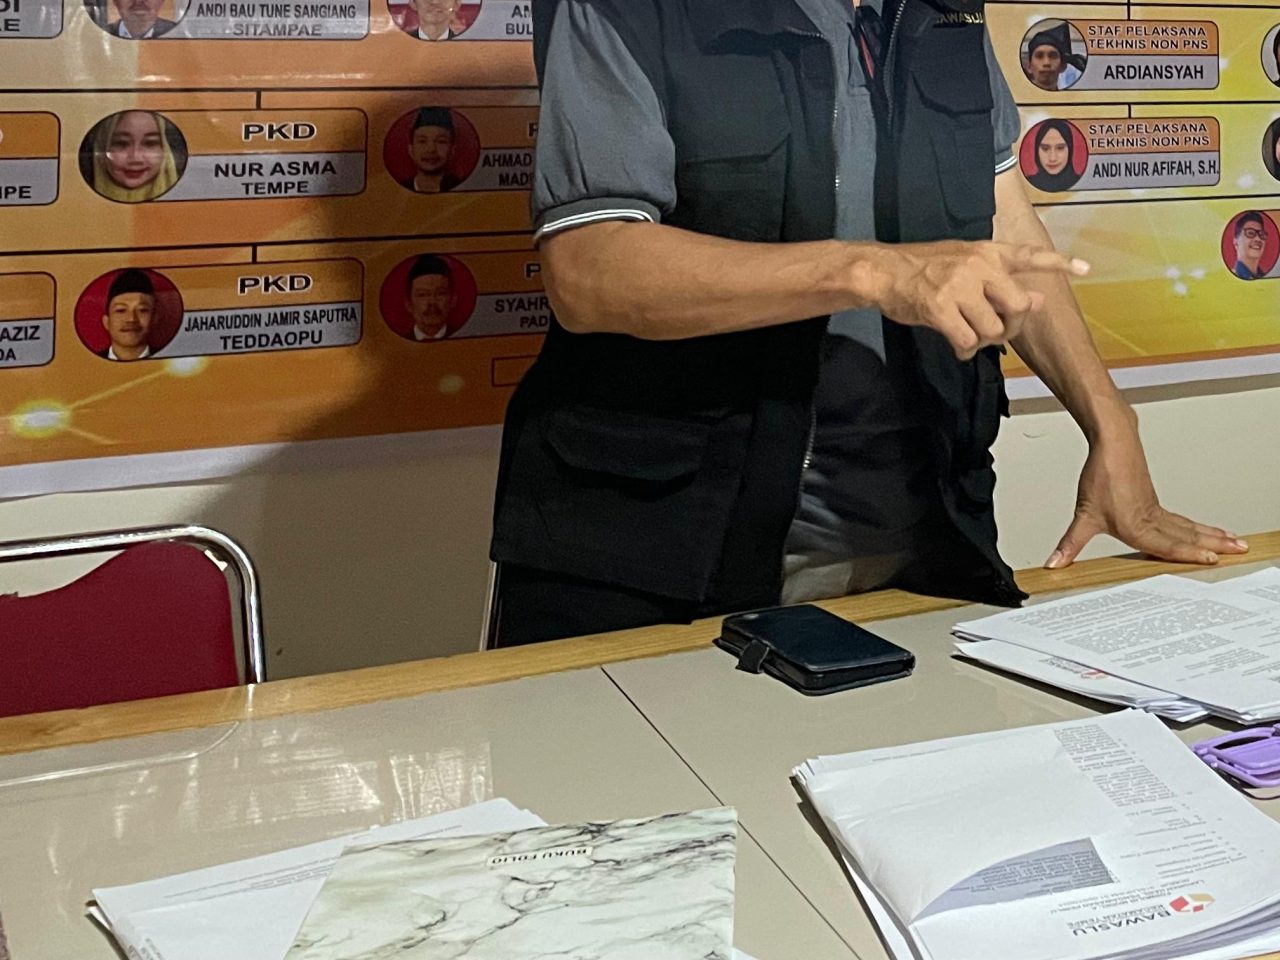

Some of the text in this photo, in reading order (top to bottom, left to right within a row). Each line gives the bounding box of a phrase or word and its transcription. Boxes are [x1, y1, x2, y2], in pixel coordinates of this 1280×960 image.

[197, 3, 356, 19] ANDI BAU TUNE SANGIANG
[0, 18, 20, 32] E
[233, 22, 322, 37] SITAMPAE
[1088, 25, 1206, 37] STAF PELAKSANA
[1089, 39, 1209, 50] TEKHNIS NON PNS
[1103, 64, 1204, 80] ARDIANSYAH
[242, 123, 316, 141] PKD
[1088, 123, 1208, 135] STAF PELAKSANA
[1089, 135, 1210, 148] TEKHNIS NON PNS
[213, 159, 337, 178] NUR ASMA
[482, 153, 532, 168] AHMAD
[1092, 159, 1219, 178] ANDI NUR AFIFAH, S.H.
[498, 172, 535, 186] MAD
[0, 186, 32, 199] PE
[241, 180, 309, 196] TEMPE
[239, 274, 312, 294] PKD
[184, 306, 357, 333] JAHARUDDIN JAMIR SAPUTRA
[220, 330, 323, 351] TEDDAOPU
[1072, 909, 1172, 936] BAWASLU
